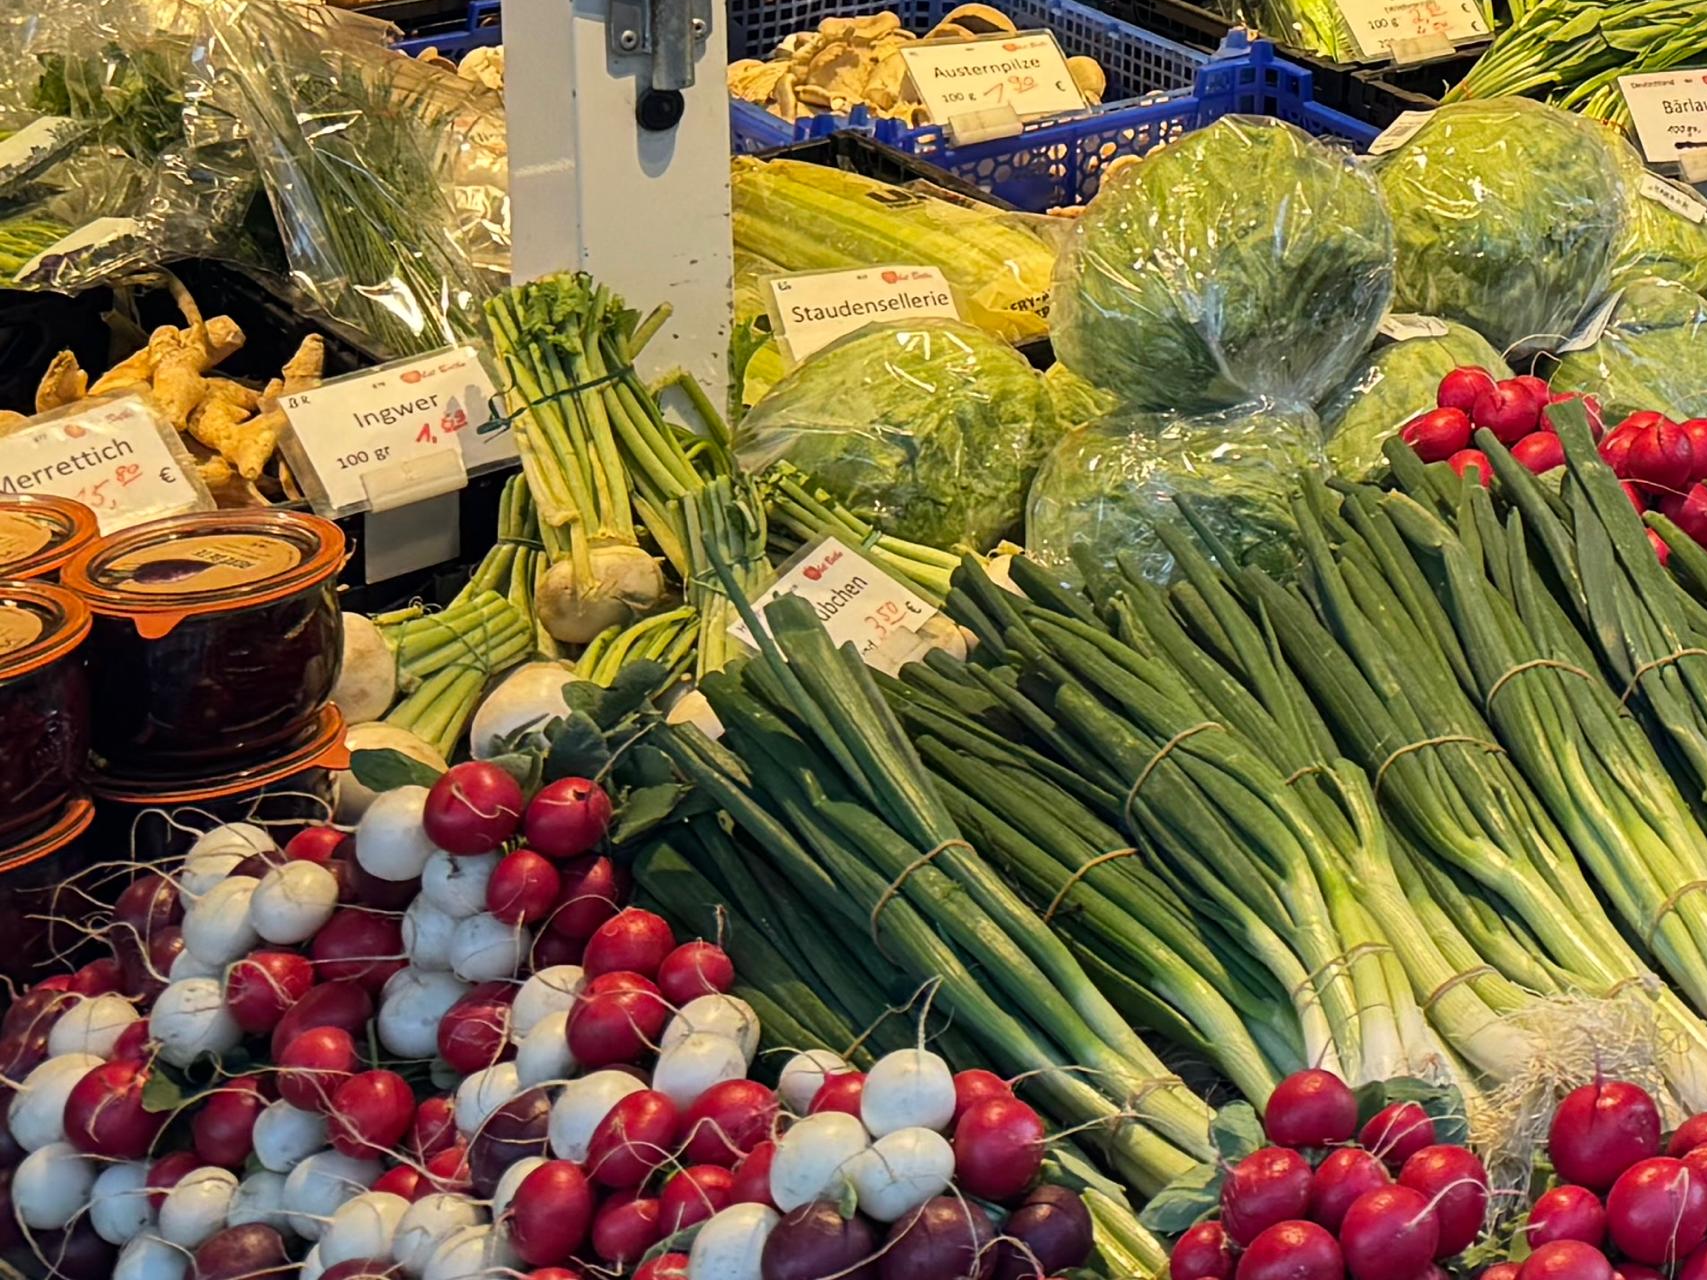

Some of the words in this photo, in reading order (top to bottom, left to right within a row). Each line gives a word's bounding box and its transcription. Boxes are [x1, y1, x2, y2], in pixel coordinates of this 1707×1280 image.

[934, 57, 1041, 79] Austernpilze
[791, 290, 950, 324] Staudensellerie
[352, 393, 439, 429] Ingwer
[336, 450, 369, 470] 100
[374, 445, 391, 462] gr
[159, 466, 177, 483] €
